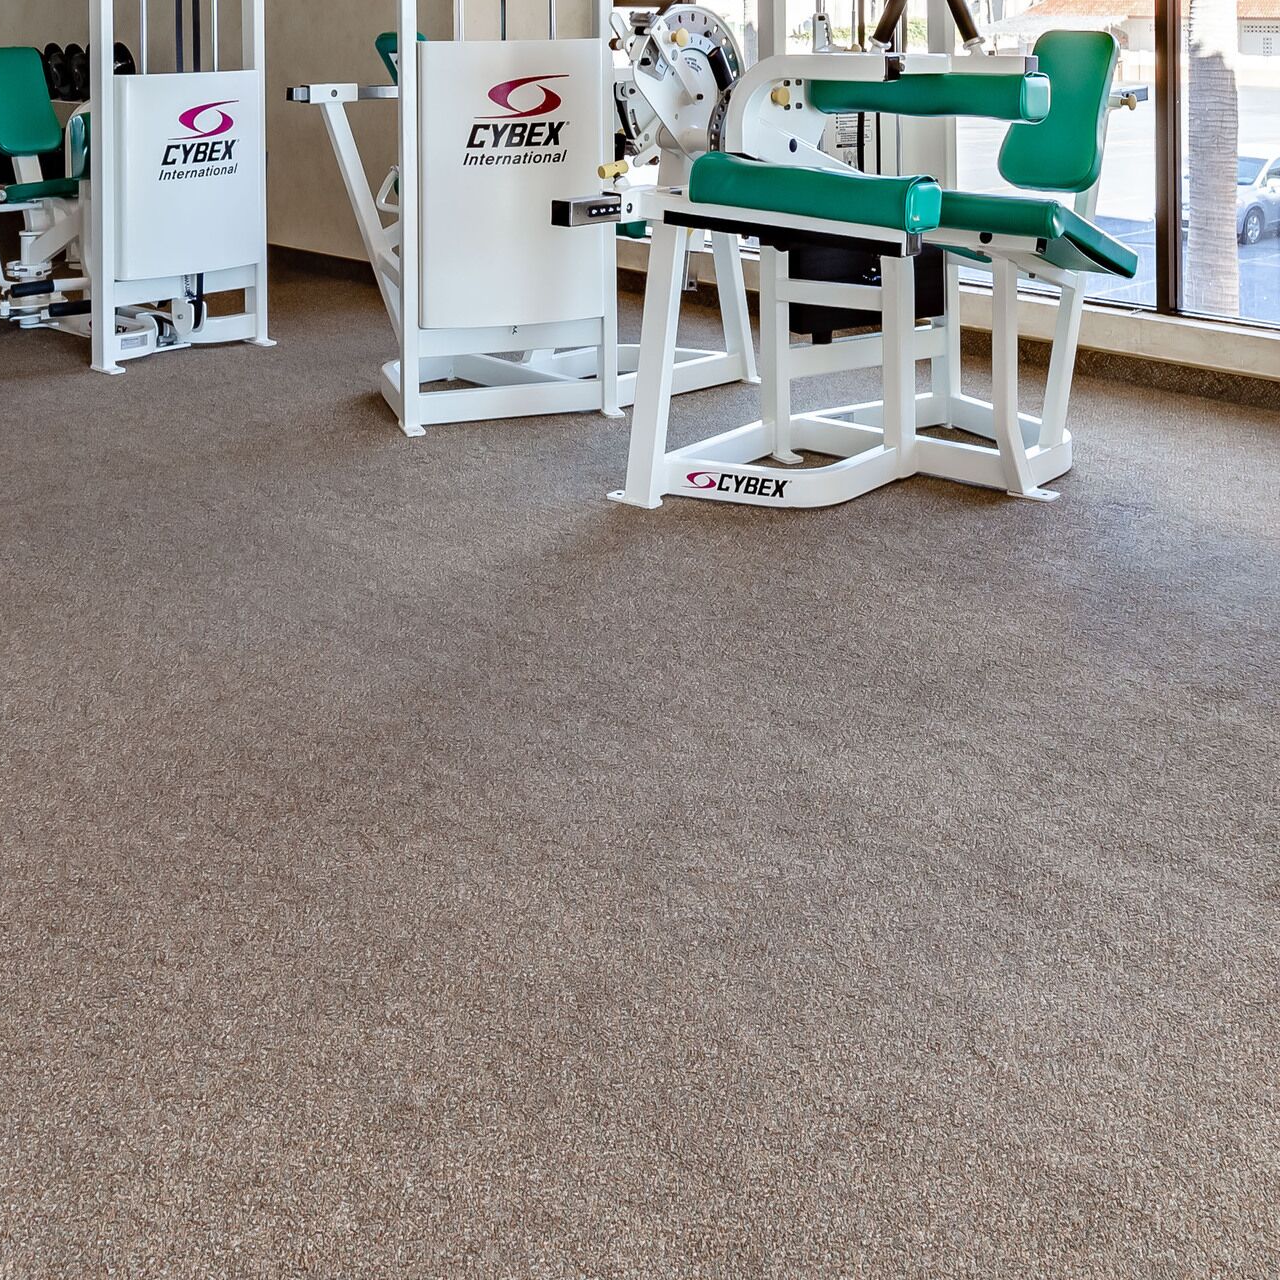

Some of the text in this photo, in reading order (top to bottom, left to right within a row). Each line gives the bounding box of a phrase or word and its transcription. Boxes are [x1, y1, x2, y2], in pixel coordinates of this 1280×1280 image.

[466, 121, 565, 148] CYBEX
[161, 140, 236, 166] CYBEX
[463, 149, 567, 165] International
[159, 163, 238, 180] International
[716, 473, 788, 498] CYBEX
